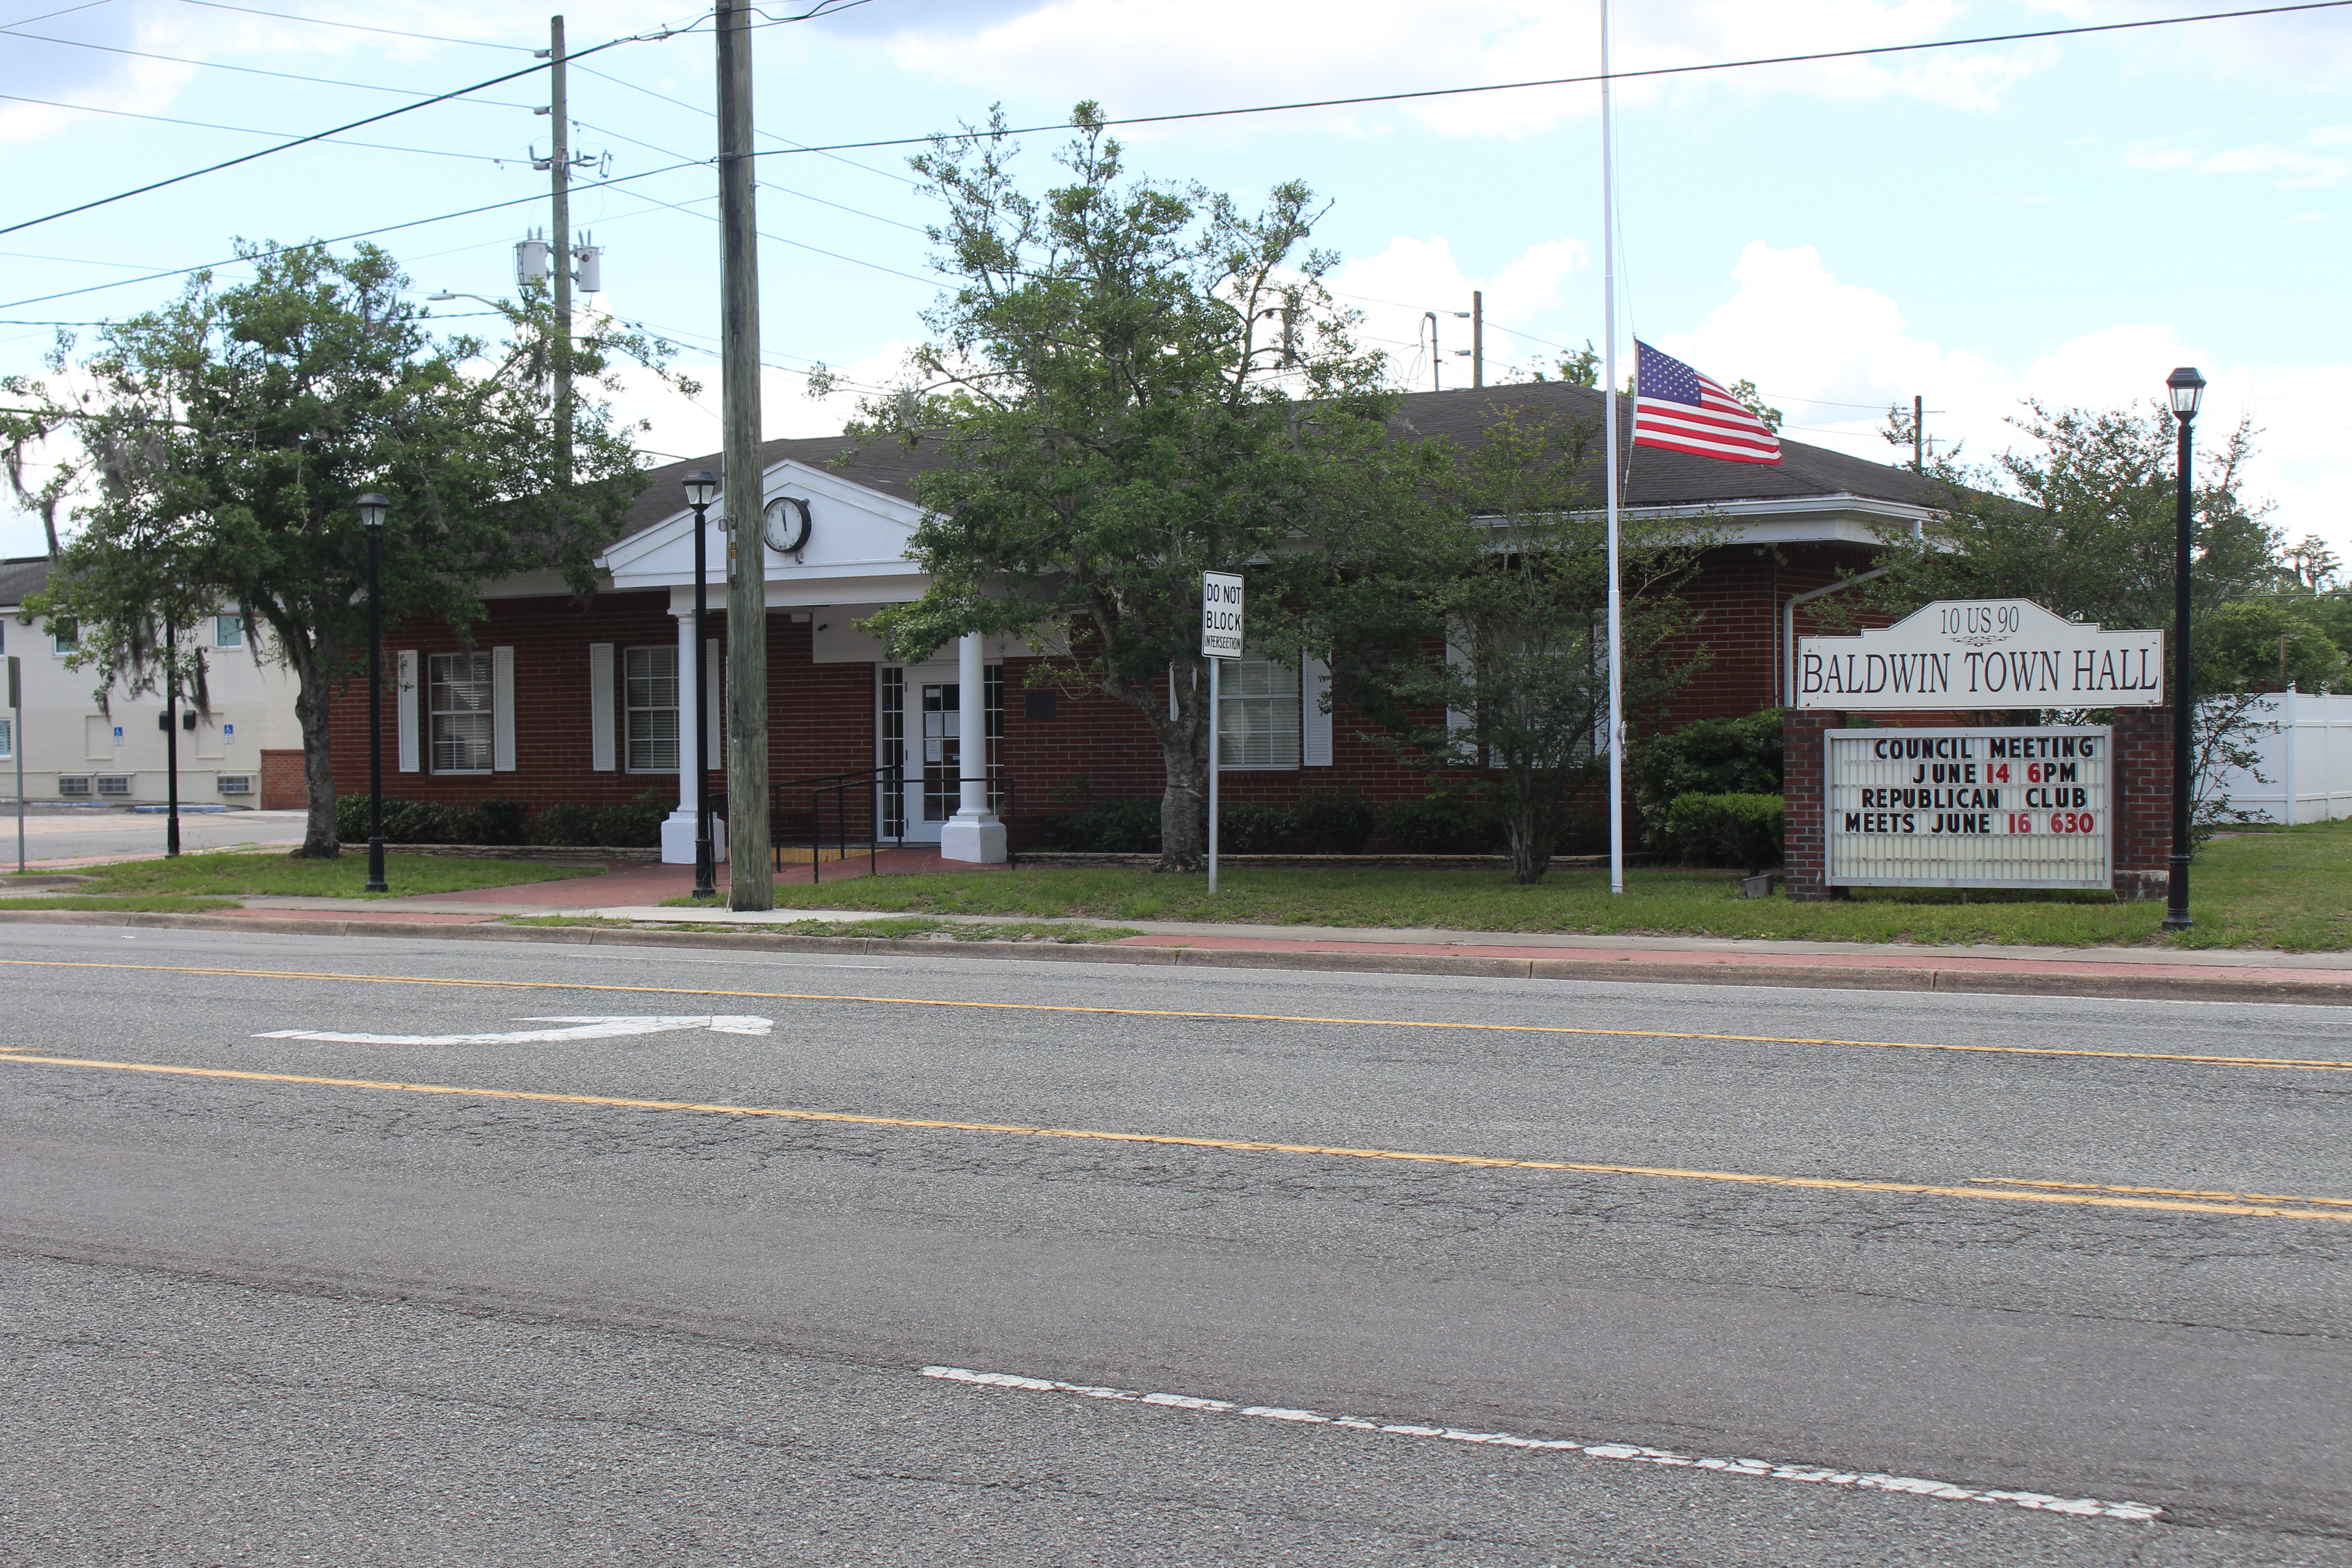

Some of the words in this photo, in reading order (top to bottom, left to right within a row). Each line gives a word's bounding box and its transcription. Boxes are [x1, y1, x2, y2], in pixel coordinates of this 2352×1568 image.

[1207, 583, 1220, 602] DO
[1224, 585, 1241, 604] NOT
[1206, 611, 1241, 632] BLOCK
[1940, 608, 1960, 634] 10
[1967, 607, 1991, 633] US
[1998, 606, 2019, 633] 90
[1205, 635, 1240, 650] INTERSECTION
[1802, 653, 1950, 693] BALDWIN
[1964, 650, 2061, 692] TOWN
[2072, 648, 2158, 691] HALL
[1875, 738, 1972, 760] COUNCIL
[1990, 737, 2093, 758] MEETING
[1913, 764, 1976, 784] JUNE
[1987, 763, 2009, 783] 14
[2028, 762, 2076, 783] 6PM
[1862, 788, 1999, 808] REPUBLICAN
[2025, 788, 2086, 808] CLUB
[1845, 813, 1915, 833] MEETS
[1931, 813, 1990, 833] JUNE
[2009, 813, 2031, 833] 16
[2050, 813, 2094, 833] 630
